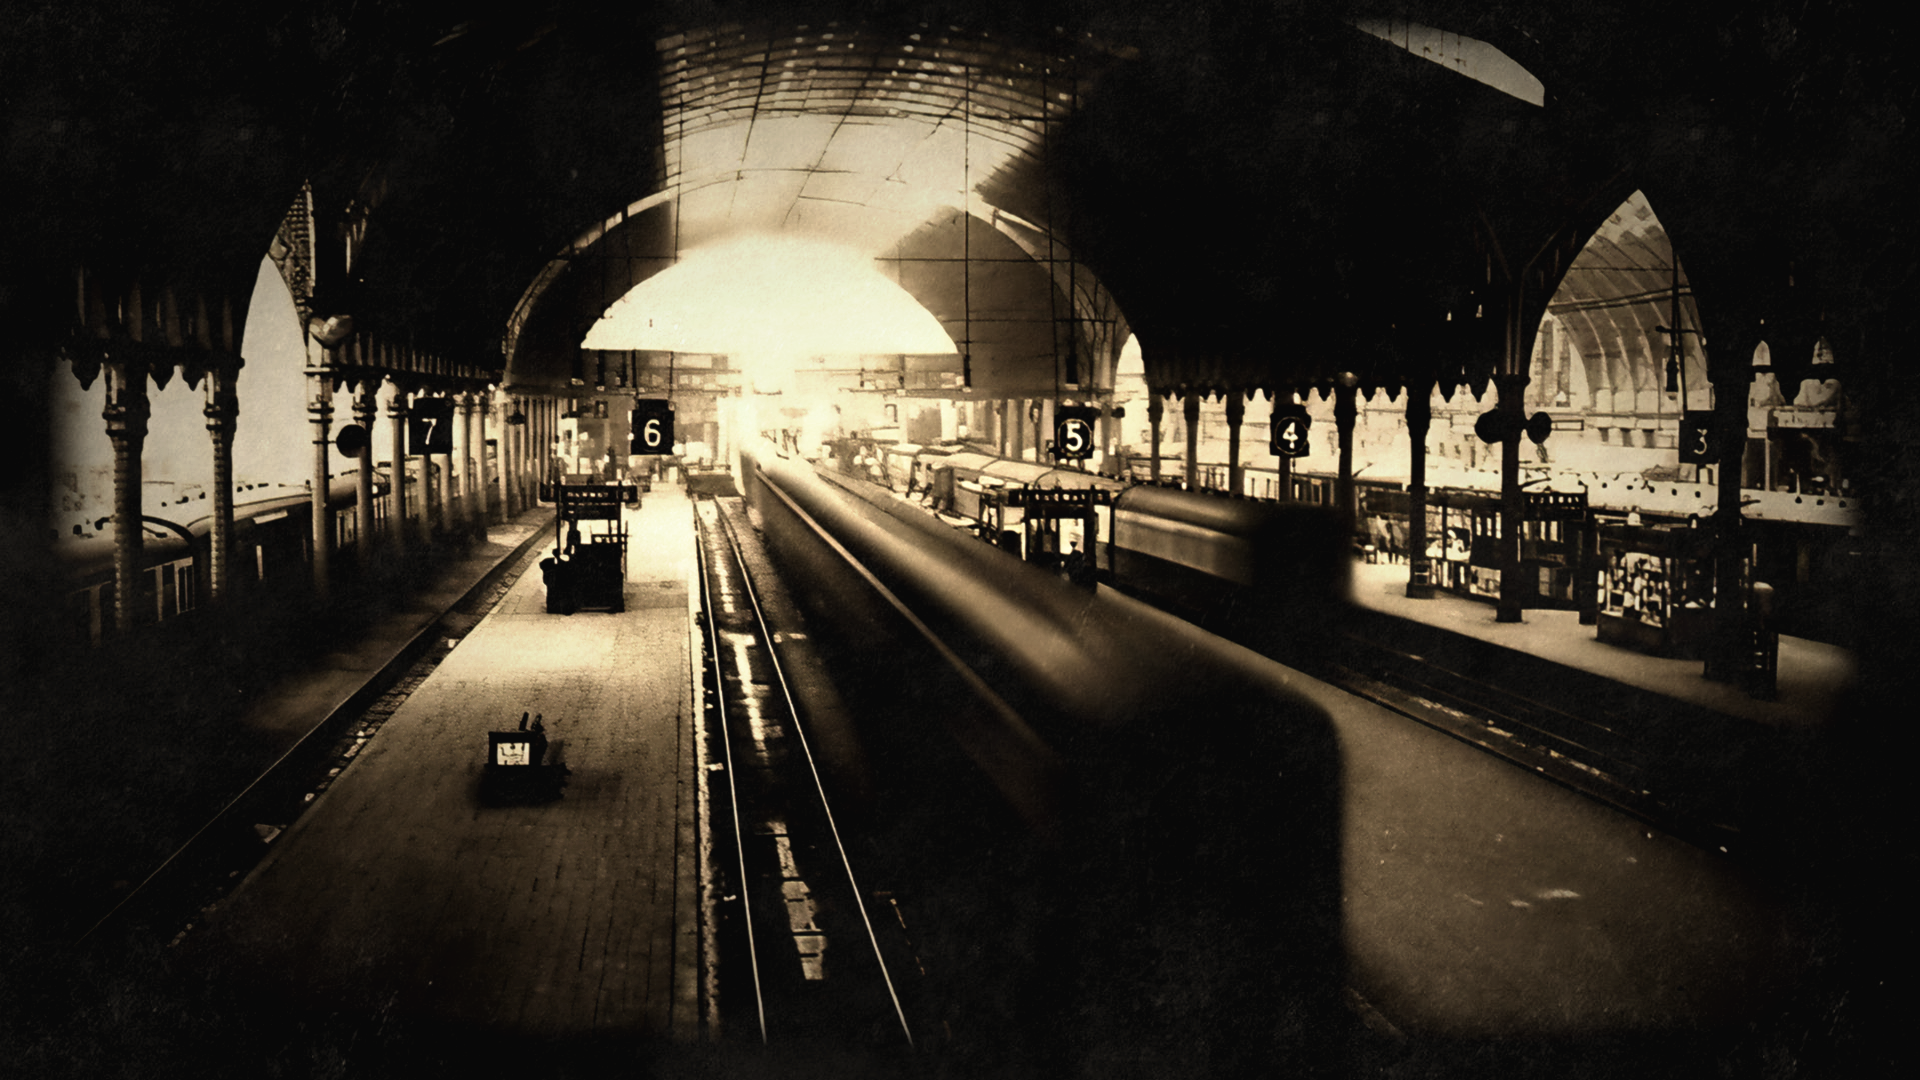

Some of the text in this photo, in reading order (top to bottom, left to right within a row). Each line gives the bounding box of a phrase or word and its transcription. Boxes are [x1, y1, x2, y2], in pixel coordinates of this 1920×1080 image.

[422, 417, 437, 445] 7
[644, 419, 661, 447] 6
[1066, 422, 1083, 452] 5
[1282, 422, 1299, 449] 4
[1694, 428, 1708, 455] 3
